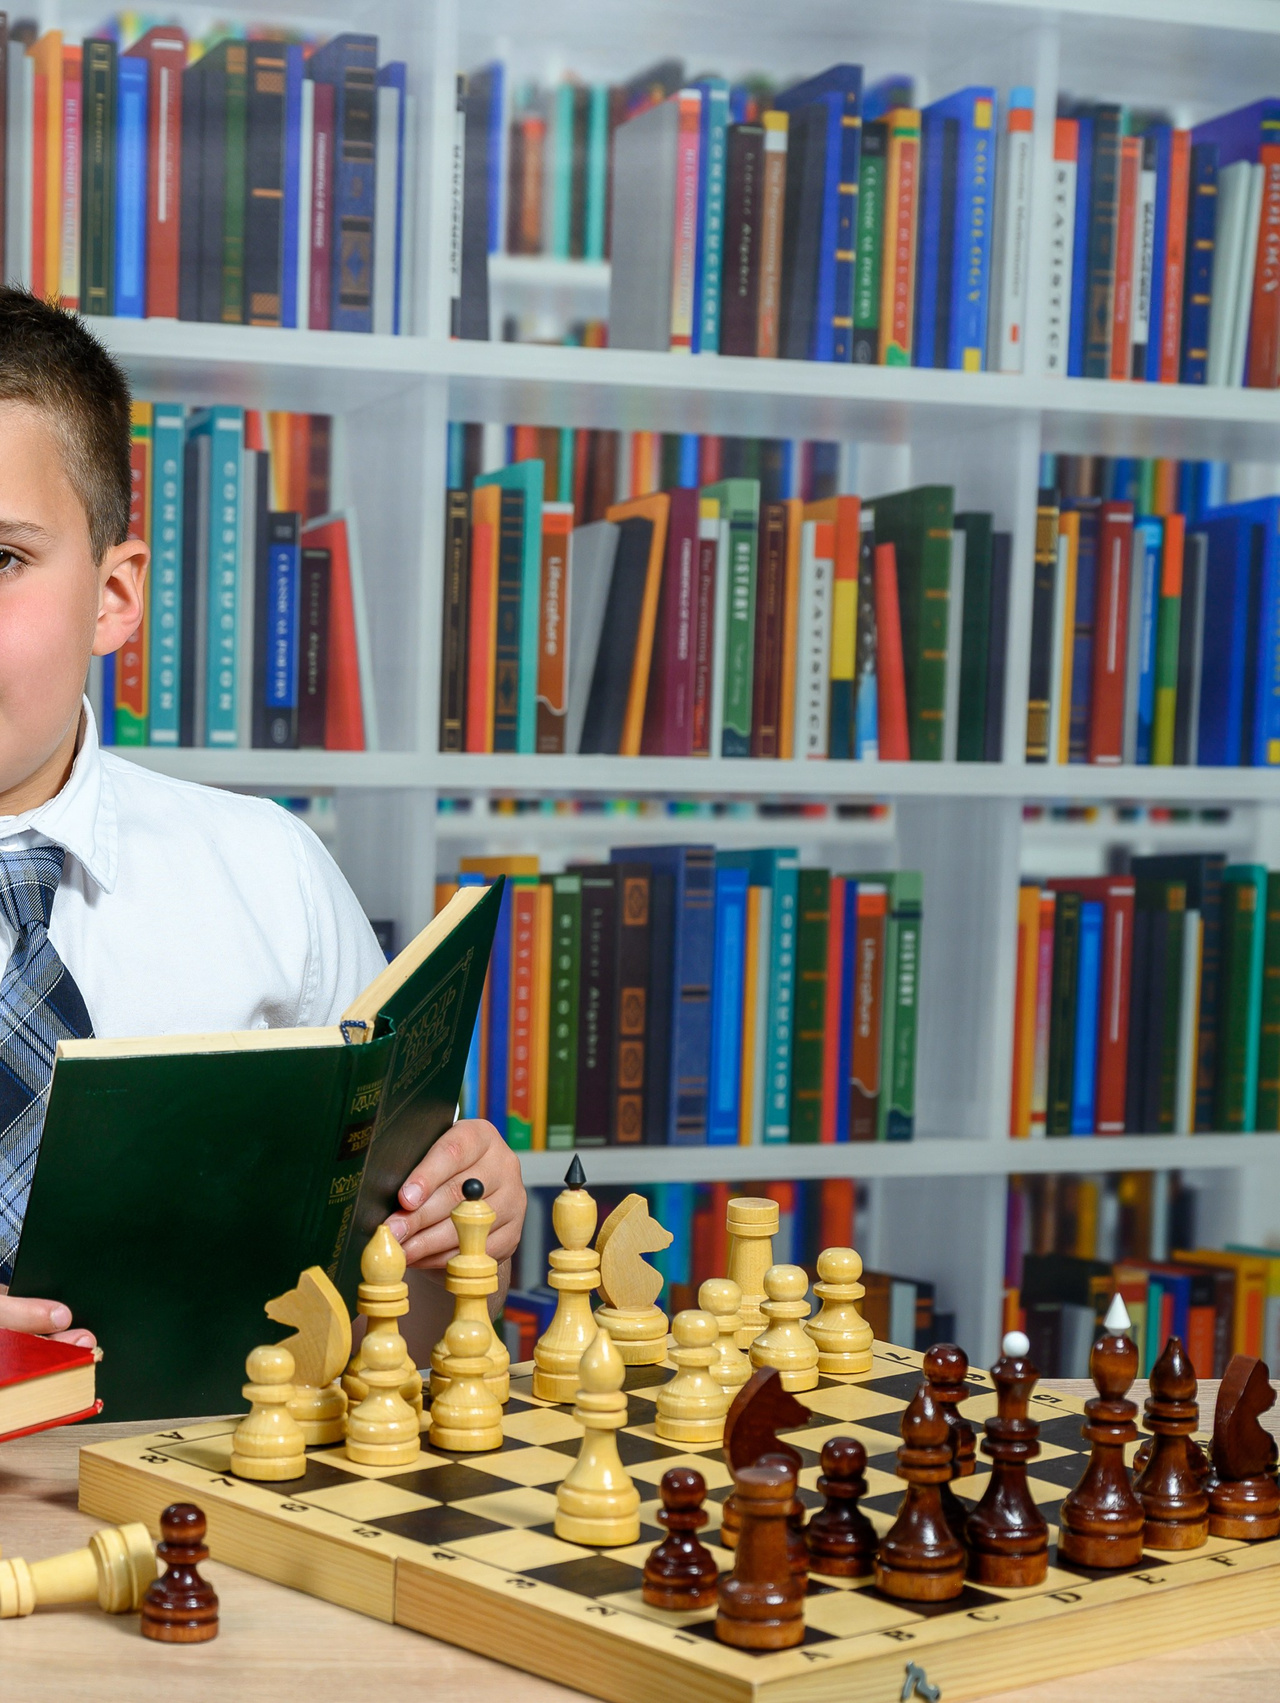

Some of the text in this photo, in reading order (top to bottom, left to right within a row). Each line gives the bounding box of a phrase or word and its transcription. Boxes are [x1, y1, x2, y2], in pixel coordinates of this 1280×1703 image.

[1048, 169, 1066, 368] STATISTICS
[161, 459, 176, 710] CONSTRUCTION
[219, 461, 237, 711] CONSTRUCTION
[545, 557, 562, 655] Literature
[733, 542, 751, 621] HISTORY
[810, 566, 825, 748] STATISTICS
[556, 913, 572, 1061] BIOLOGY
[774, 894, 794, 1110] CONSTRUCTION
[859, 938, 876, 1038] Literature
[899, 930, 916, 1007] HISTORY
[400, 985, 458, 1056] ЖЮЛЬ
[403, 1007, 448, 1072] ВЕРН
[347, 1126, 373, 1143] ЖЮ
[350, 1138, 370, 1152] ВЕ
[1031, 1394, 1064, 1404] 5
[139, 1454, 699, 1645] 8 7 6 5 4 3 2 1
[800, 1554, 1239, 1663] A B C D E F
